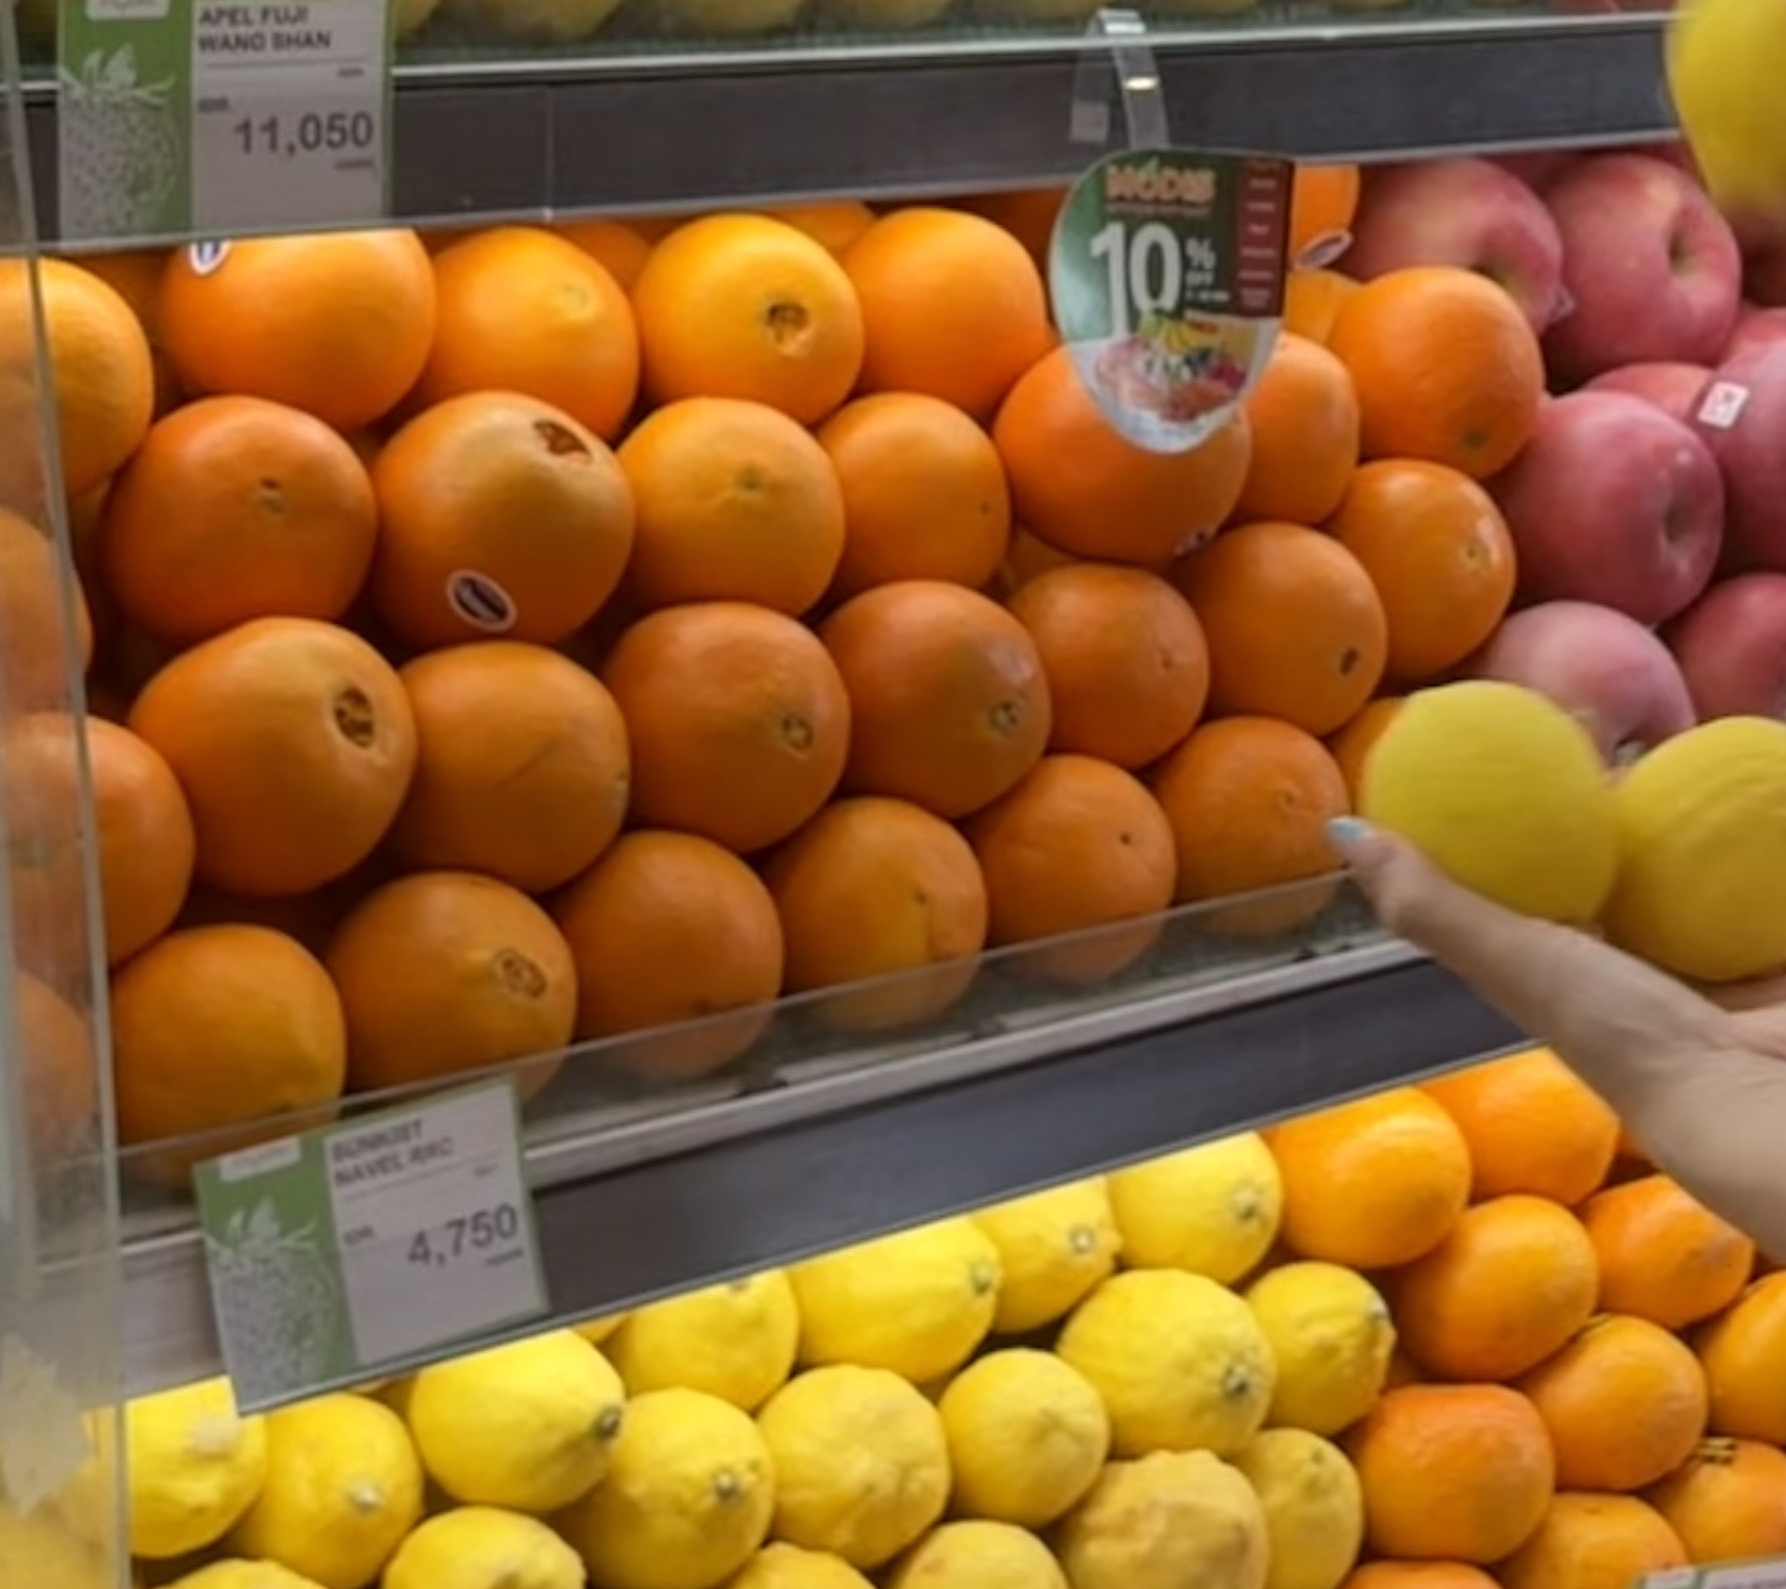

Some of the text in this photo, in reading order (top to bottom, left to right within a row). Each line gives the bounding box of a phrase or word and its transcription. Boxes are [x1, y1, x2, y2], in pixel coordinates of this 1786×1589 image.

[199, 5, 309, 28] APEL FUJI
[235, 112, 374, 156] 11,050
[407, 1203, 518, 1266] 4,750
